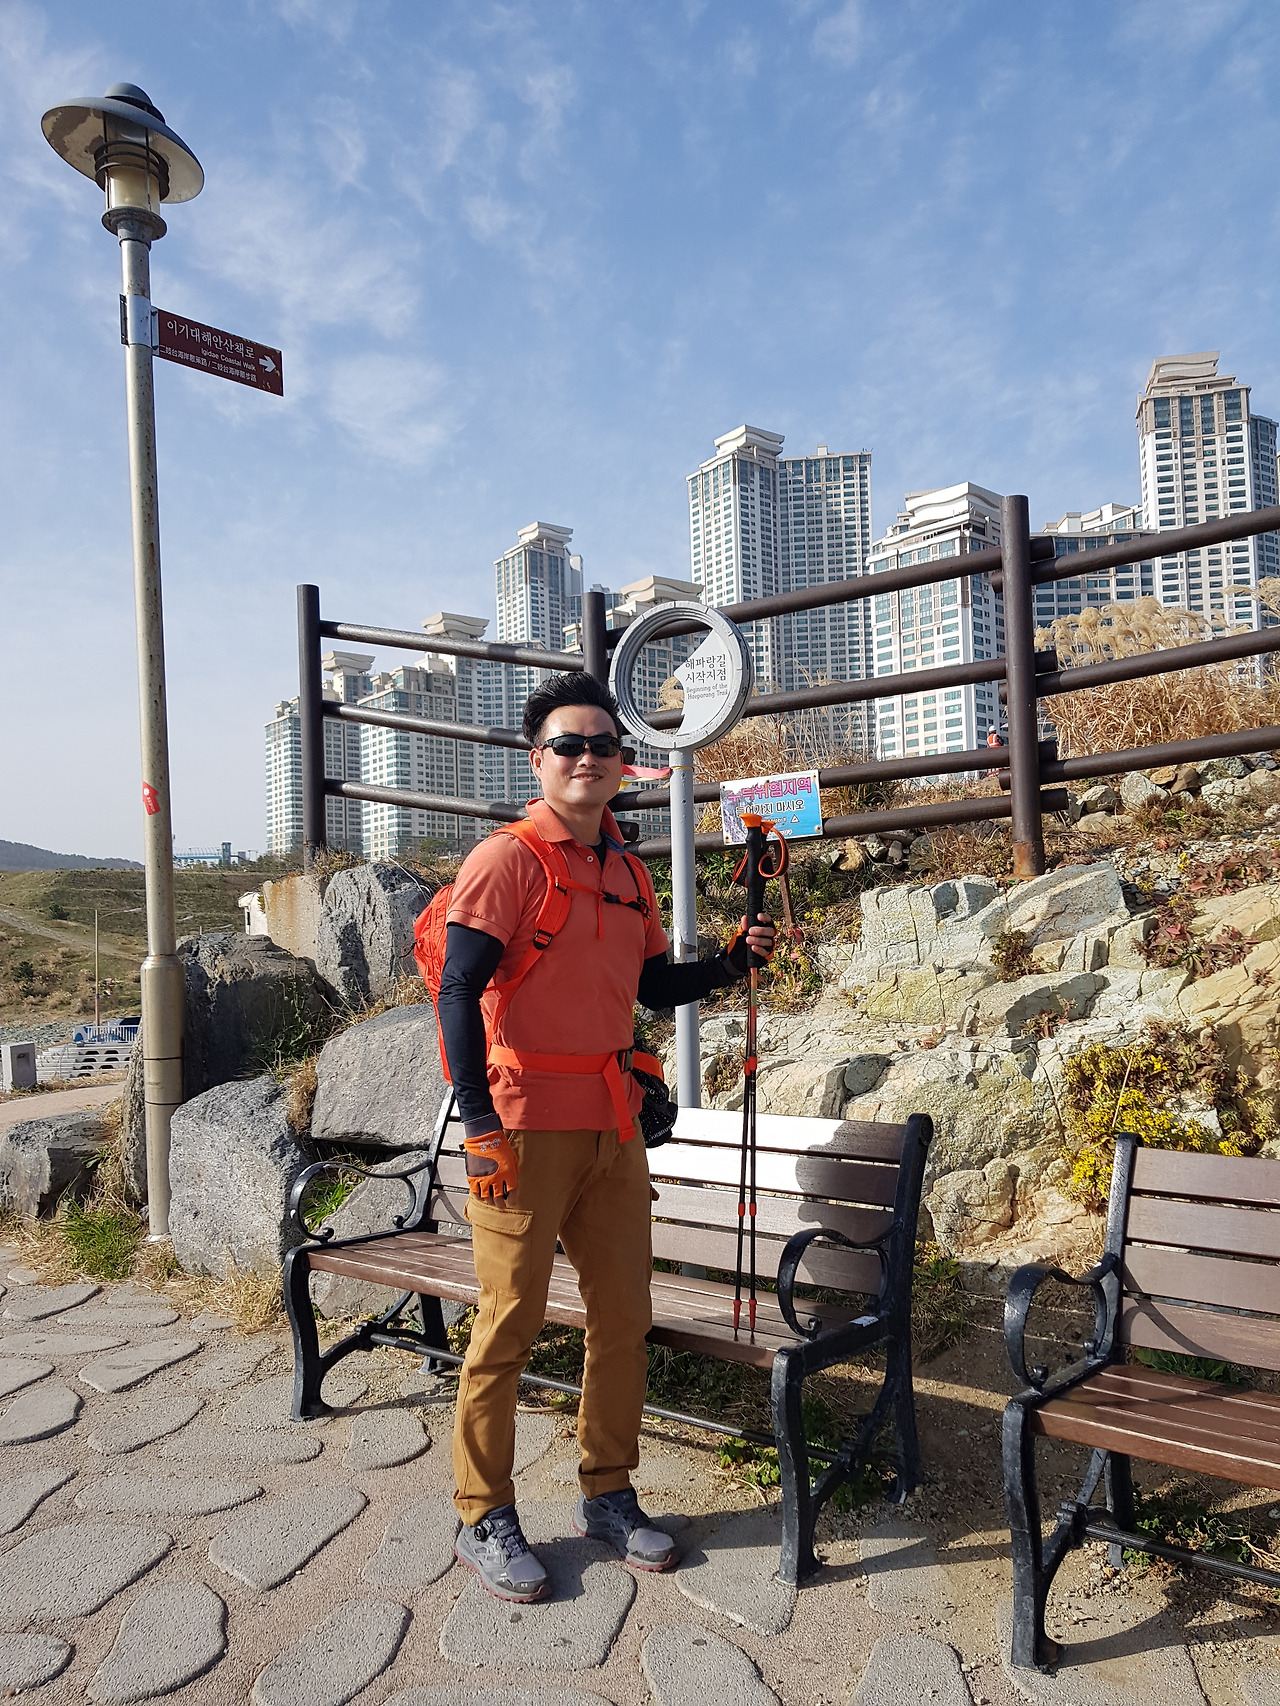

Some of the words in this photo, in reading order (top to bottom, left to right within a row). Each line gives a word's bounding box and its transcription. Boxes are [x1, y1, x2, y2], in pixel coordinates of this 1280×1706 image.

[166, 319, 256, 359] 이기대해안산책로
[201, 347, 220, 360] Igidae
[220, 354, 242, 367] Coastal
[242, 361, 257, 372] Walk
[685, 653, 727, 670] 해파랑길
[685, 668, 727, 684] 시작지점
[686, 686, 711, 694] Beginning
[776, 799, 805, 813] 마시오
